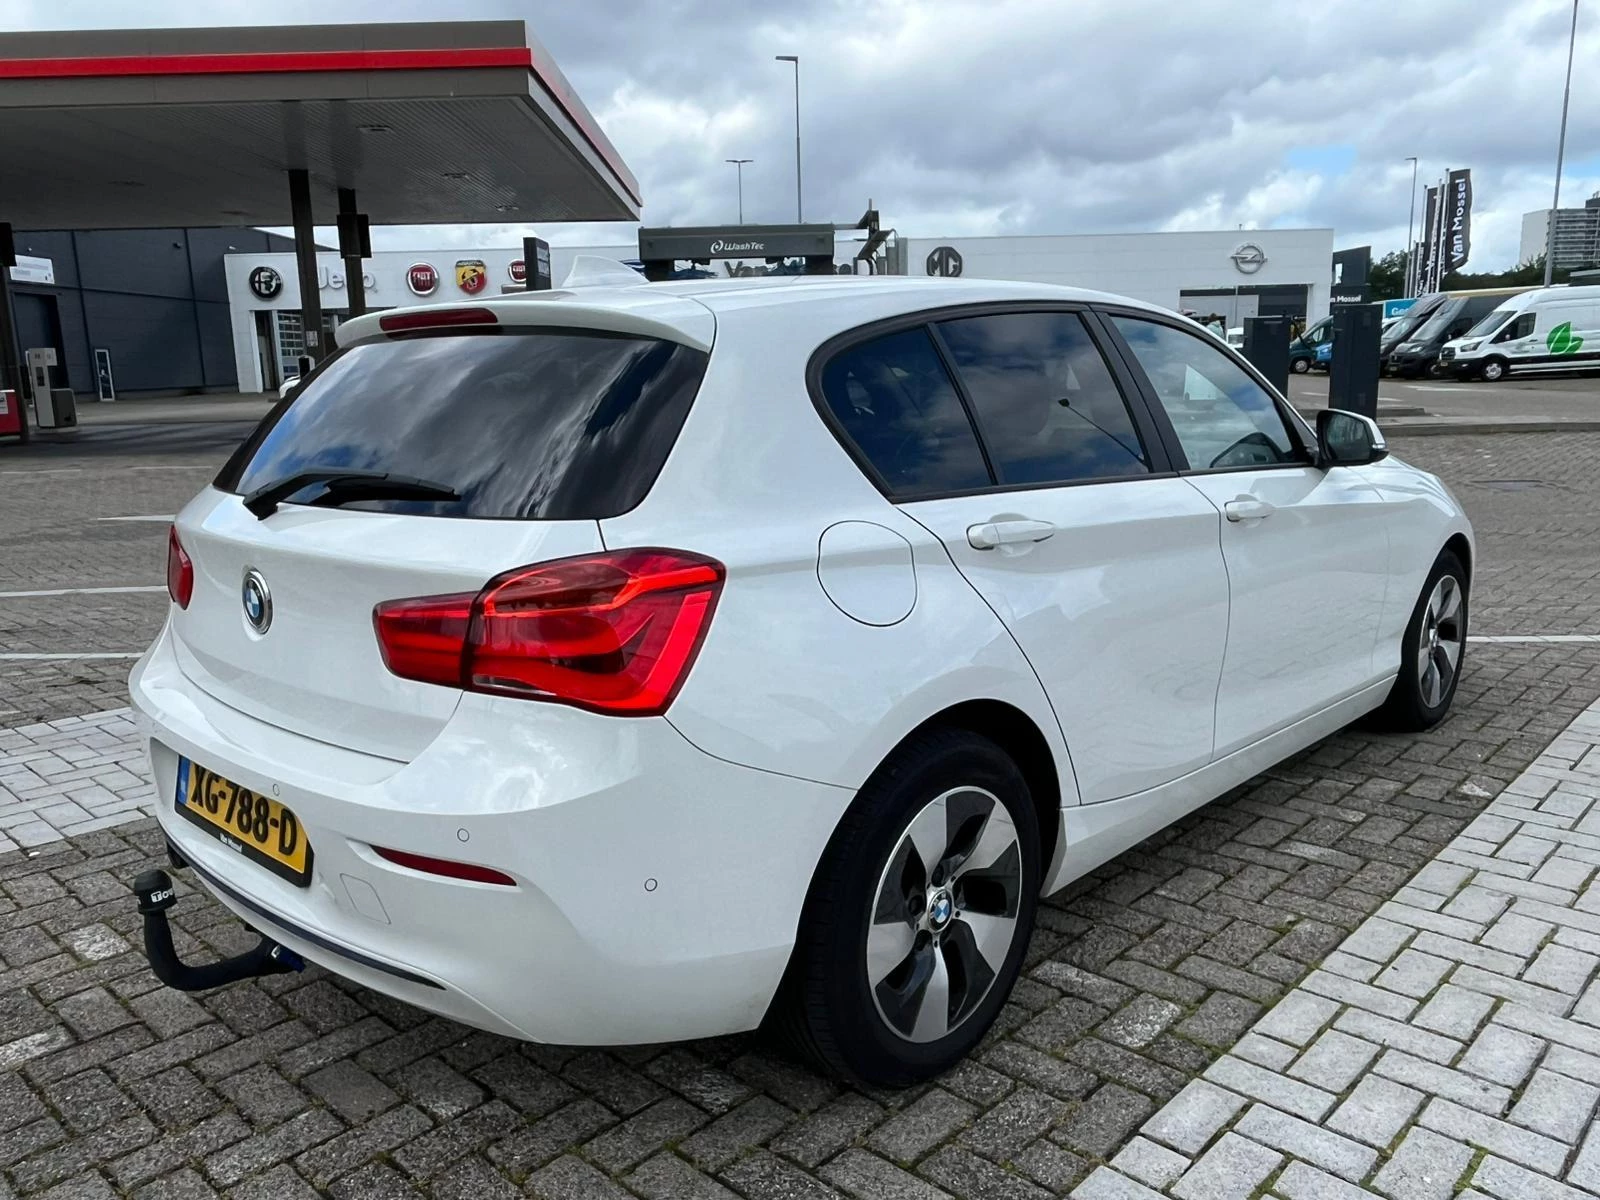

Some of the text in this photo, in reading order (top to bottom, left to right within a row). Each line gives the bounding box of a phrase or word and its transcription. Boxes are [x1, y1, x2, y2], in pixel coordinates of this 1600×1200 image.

[724, 241, 764, 252] WashTec
[1452, 178, 1466, 262] Van Mossel
[926, 246, 963, 277] MG
[191, 762, 297, 856] XG-788-D
